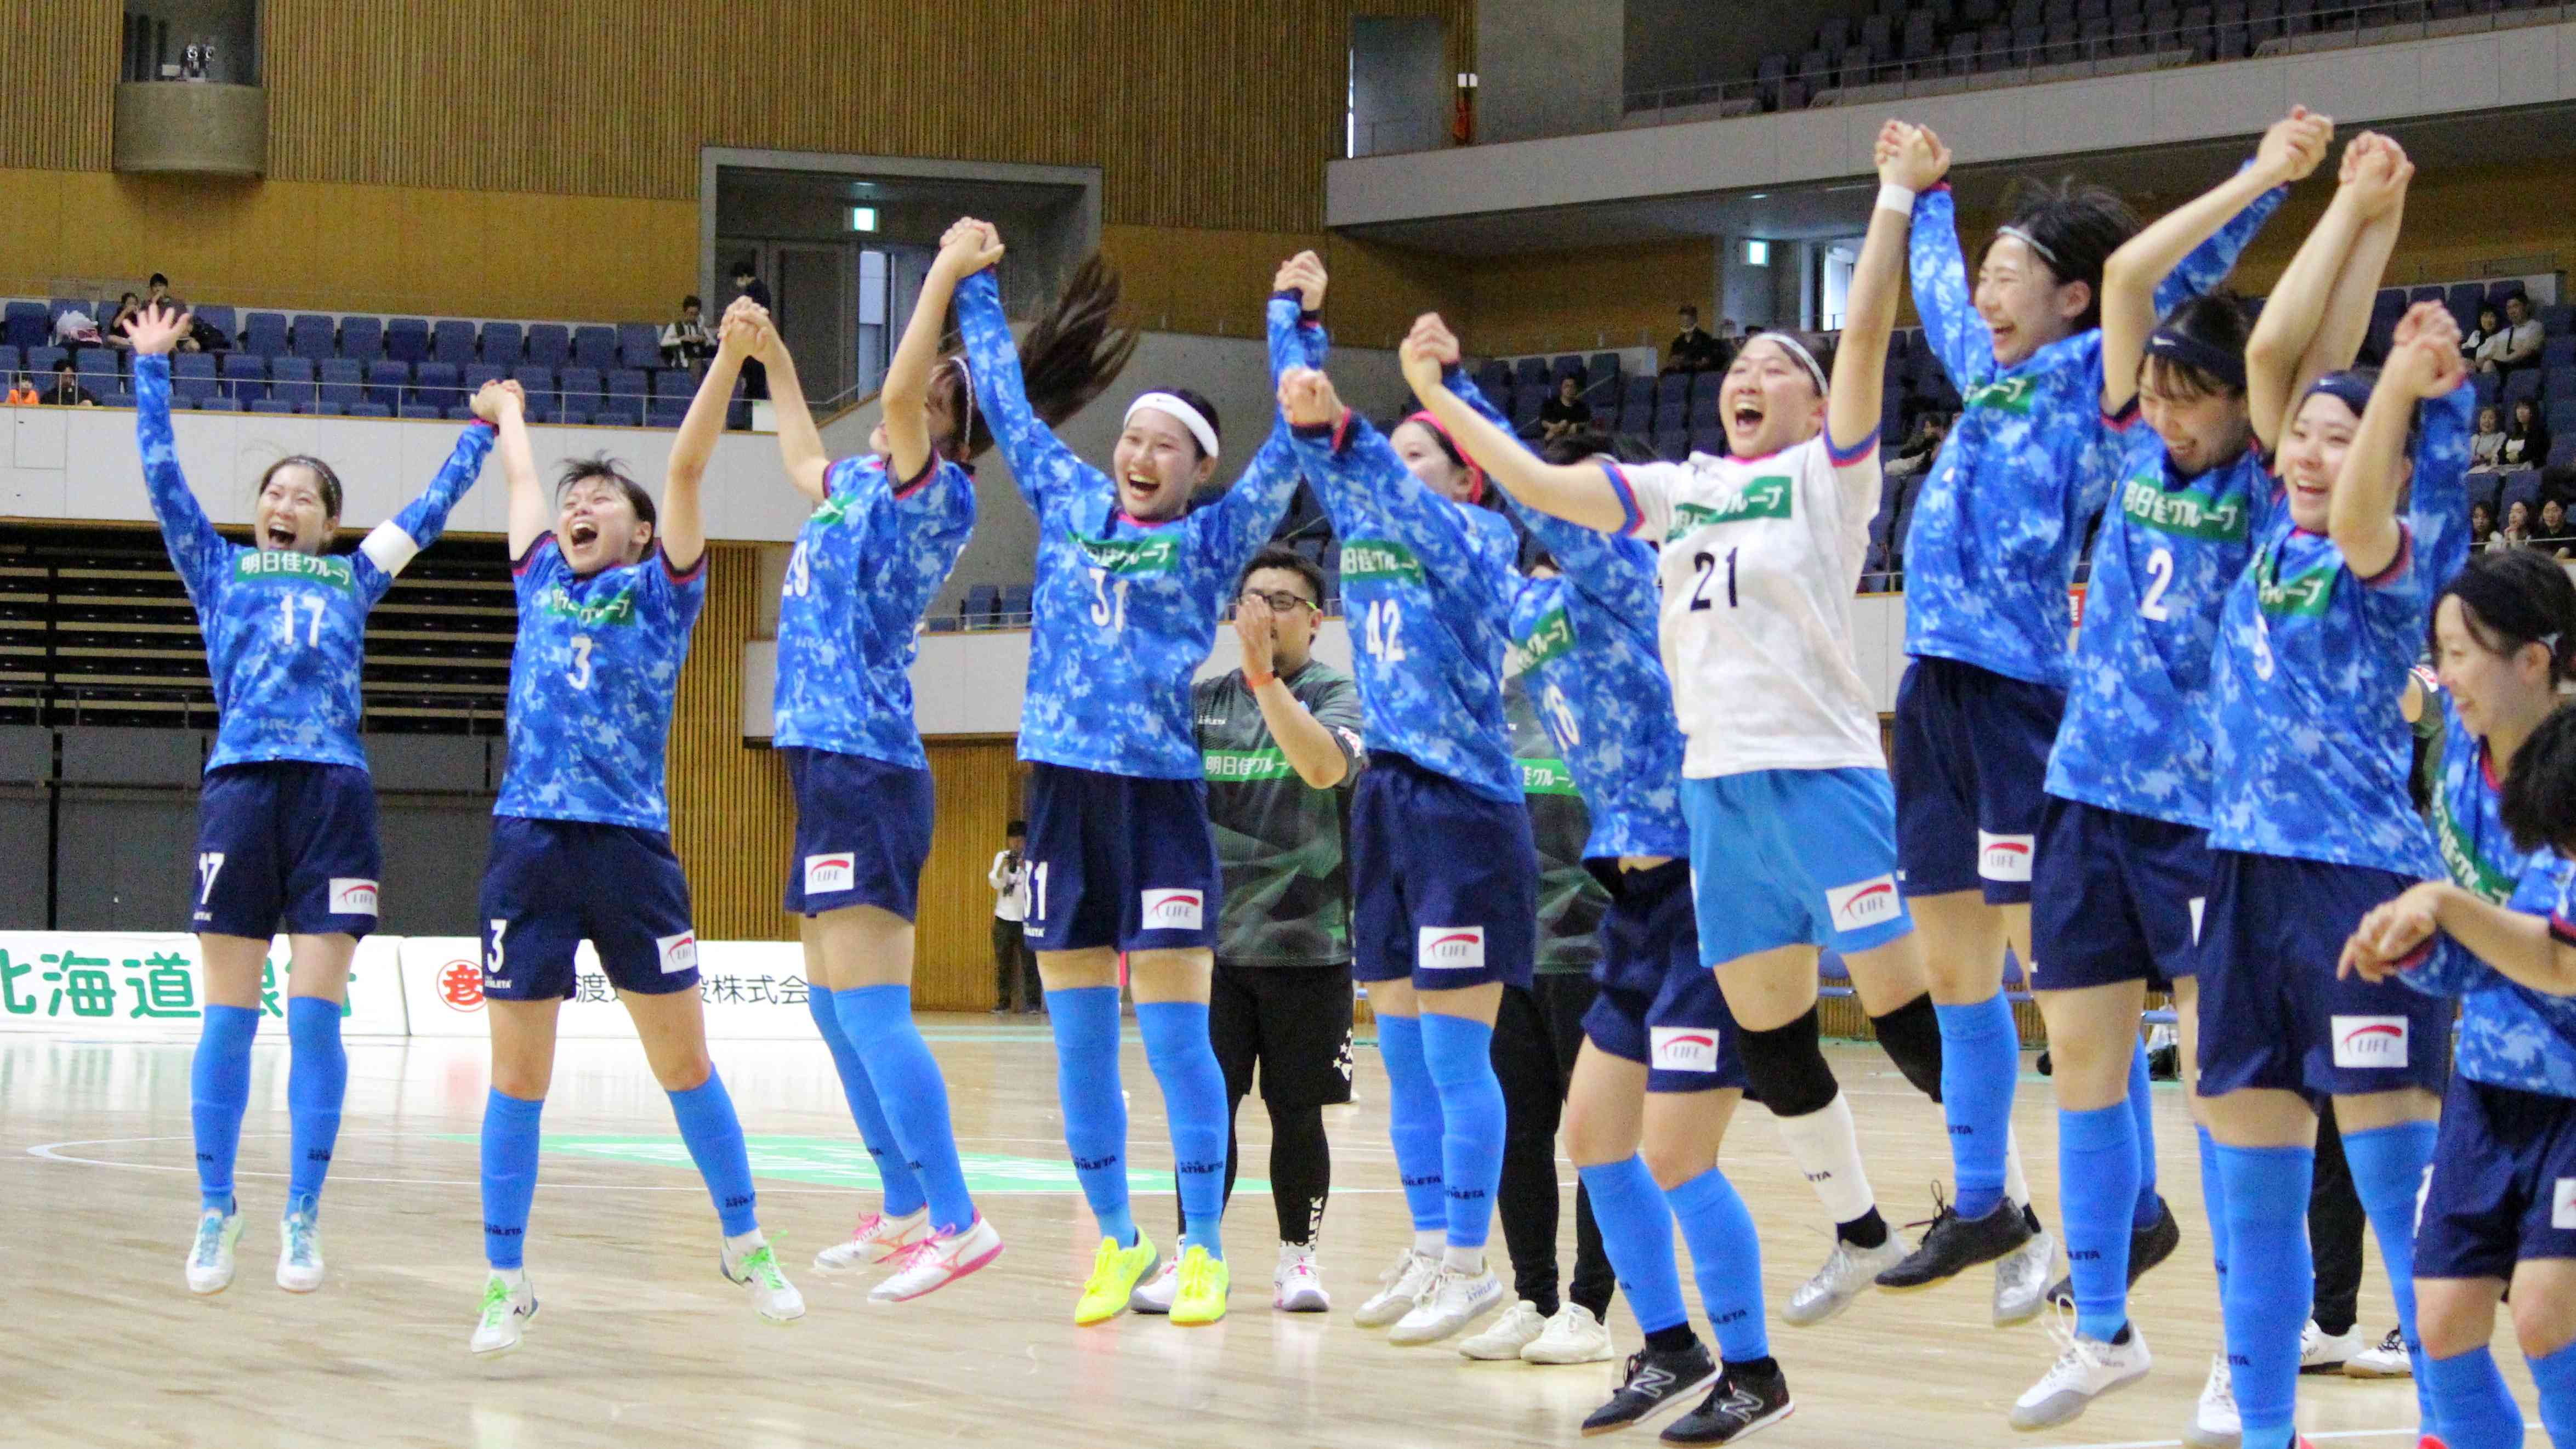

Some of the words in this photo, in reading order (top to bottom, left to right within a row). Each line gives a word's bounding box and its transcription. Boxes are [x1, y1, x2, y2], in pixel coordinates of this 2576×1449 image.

[241, 552, 350, 586] 明日佳グループ
[1690, 547, 1738, 611] 21
[2141, 549, 2173, 622] 2
[281, 595, 326, 647] 17
[1367, 600, 1405, 661] 42
[566, 635, 592, 690] 3
[487, 919, 508, 973] 3
